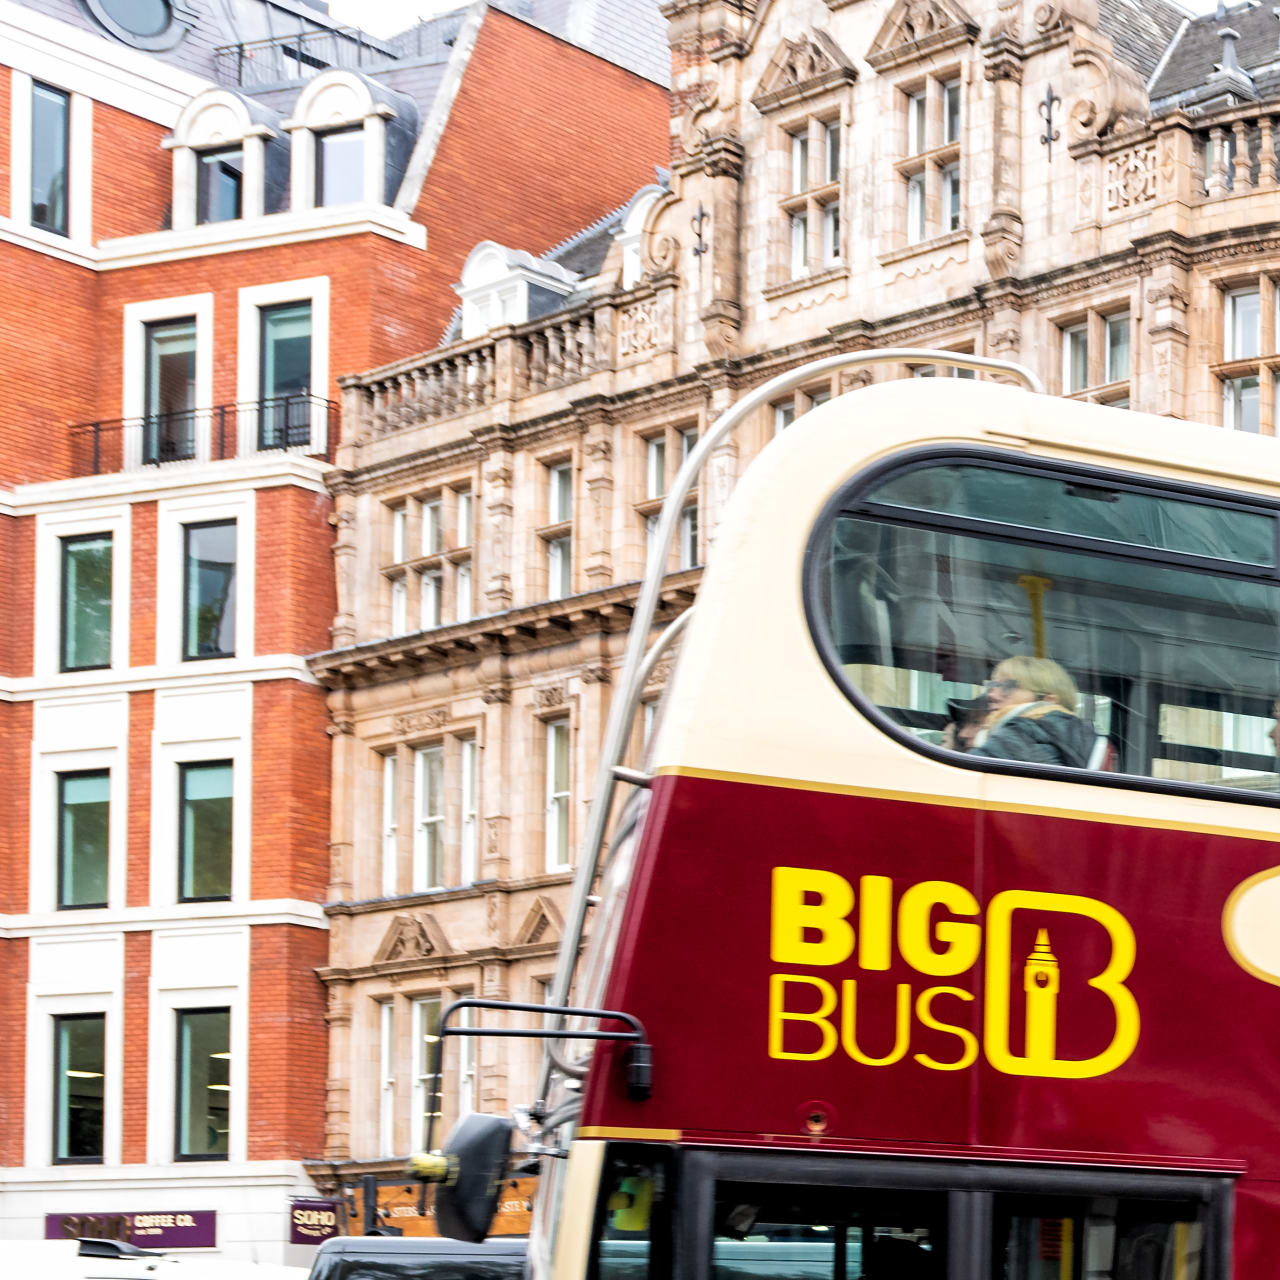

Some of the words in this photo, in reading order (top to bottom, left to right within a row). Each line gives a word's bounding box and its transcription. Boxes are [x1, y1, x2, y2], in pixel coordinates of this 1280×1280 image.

[770, 866, 982, 977] BIG
[768, 973, 979, 1071] BUS
[134, 1214, 177, 1228] COFFEE
[175, 1214, 198, 1228] CO.
[293, 1210, 336, 1225] SOHO
